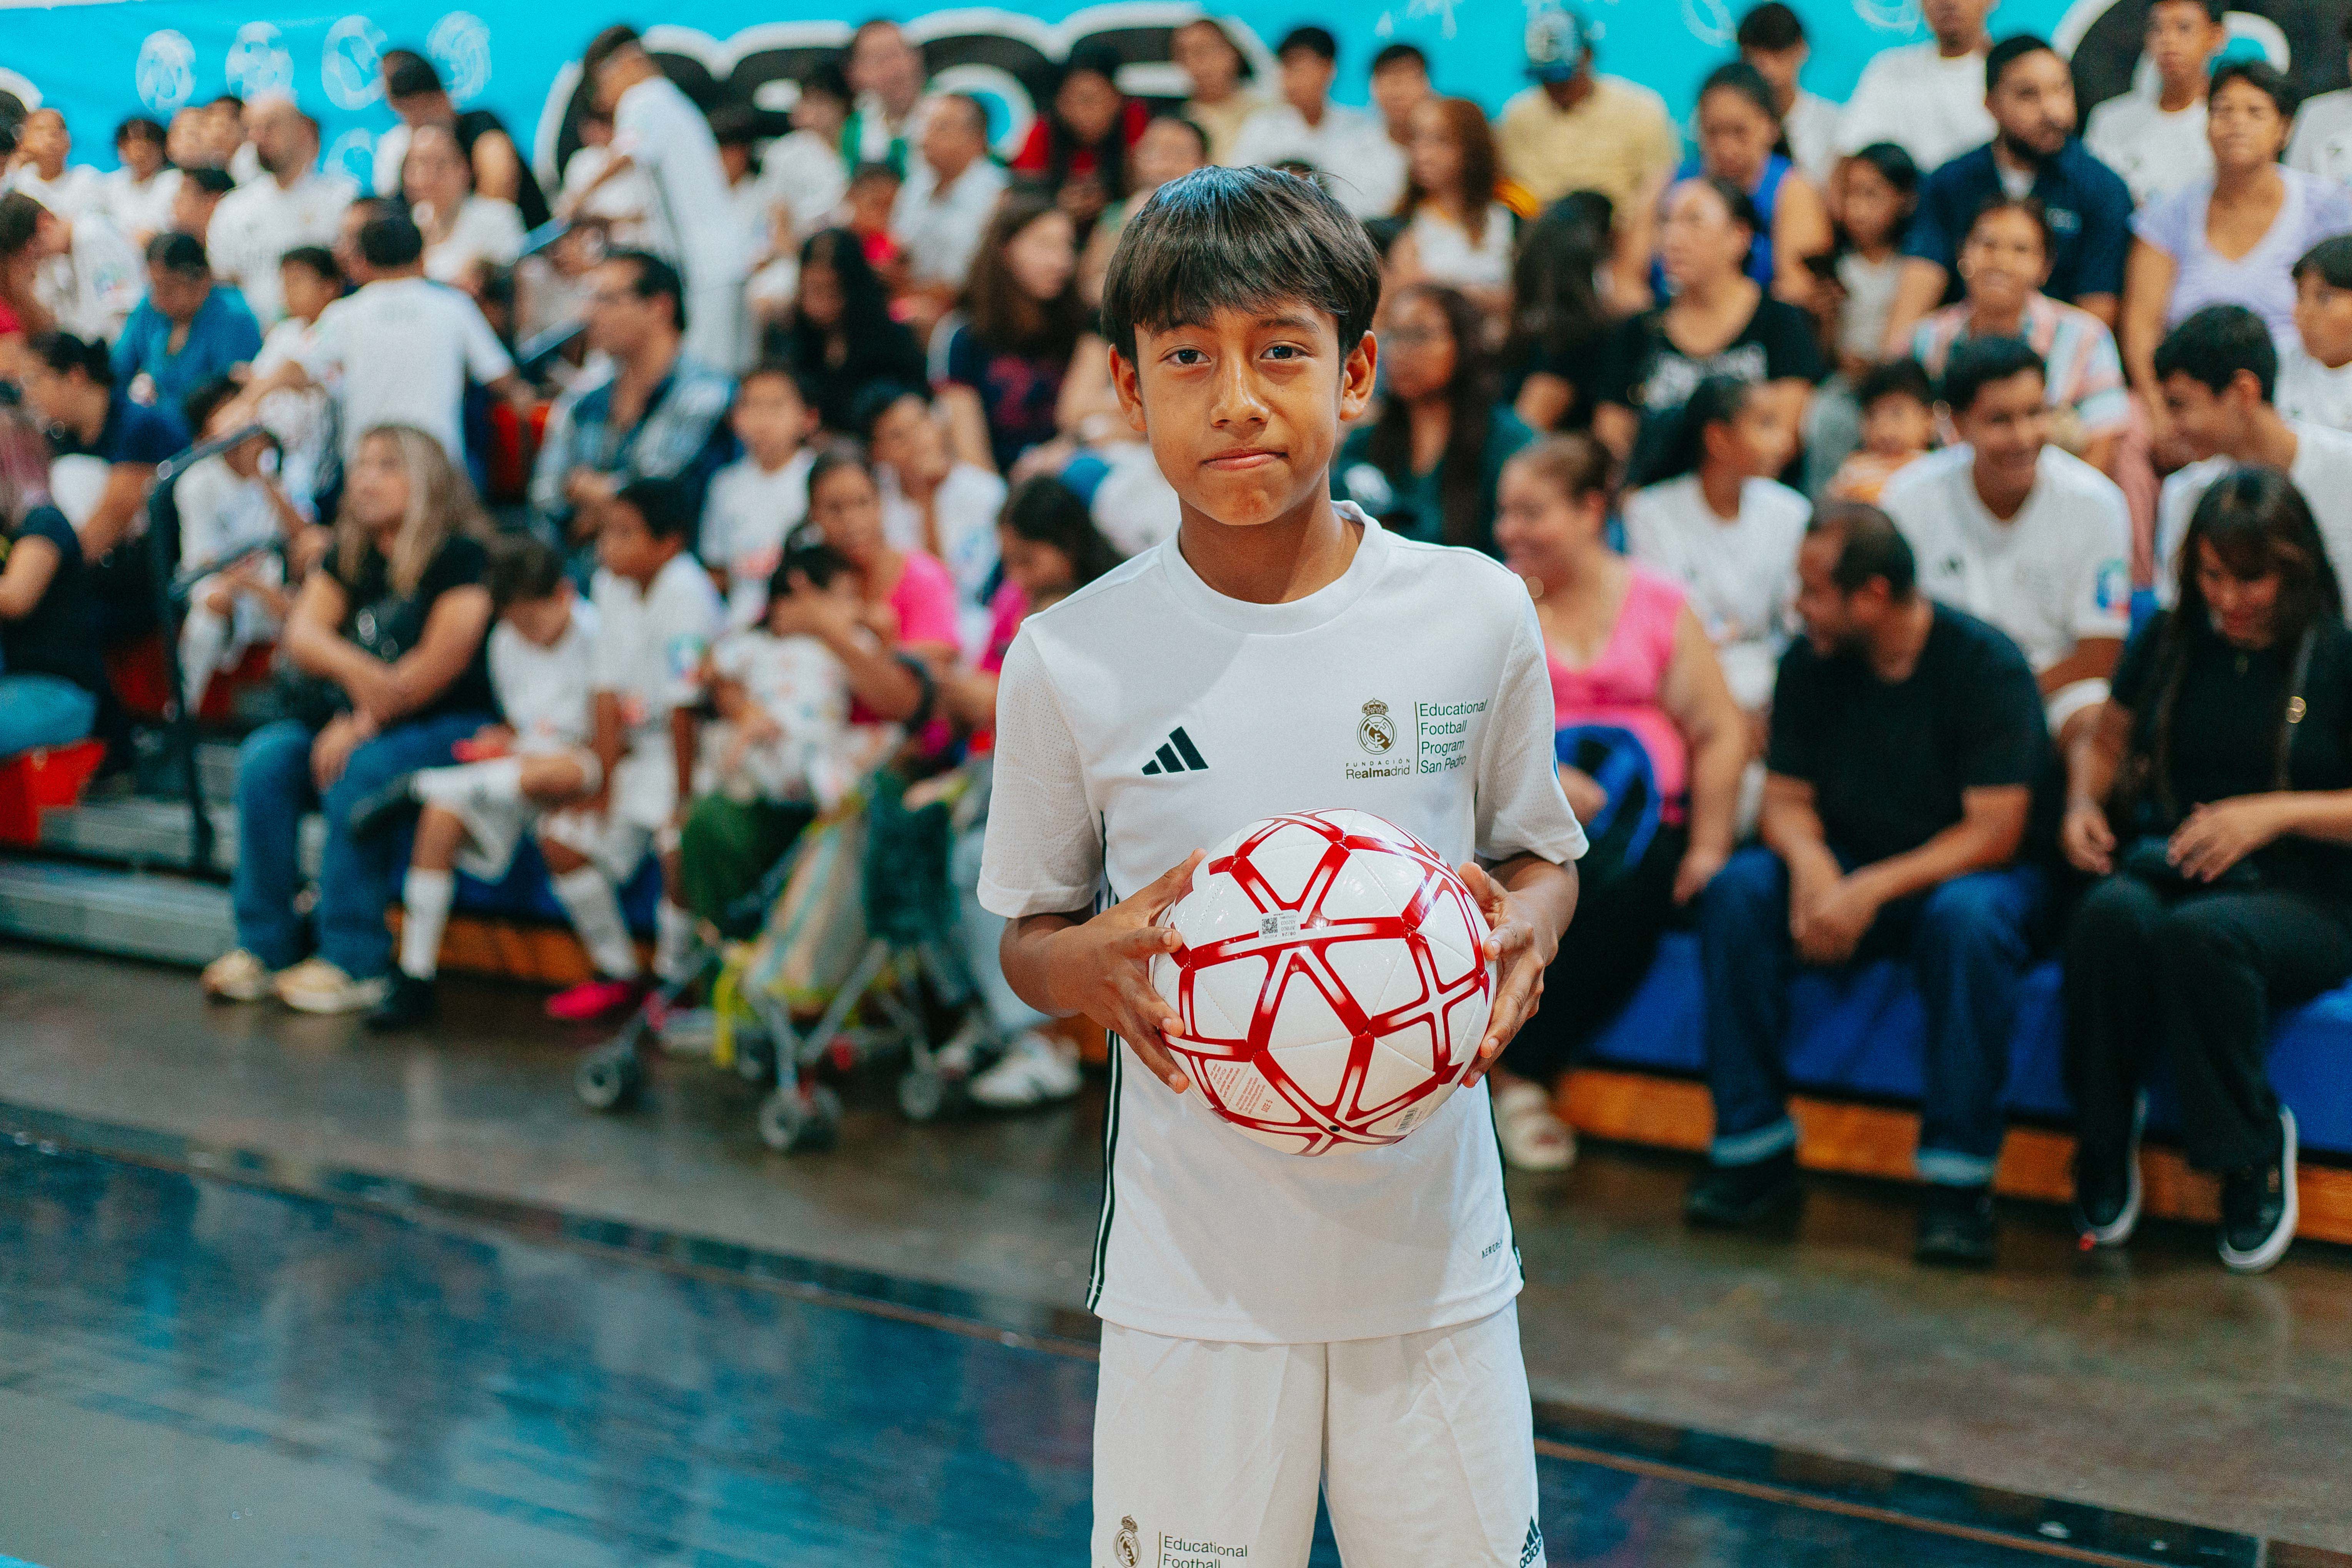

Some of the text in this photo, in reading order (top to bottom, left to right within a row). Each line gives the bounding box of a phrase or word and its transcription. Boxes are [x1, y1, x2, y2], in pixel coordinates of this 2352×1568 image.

[1420, 699, 1488, 717] Educational
[1421, 719, 1467, 736] Football
[1421, 740, 1465, 756] Program
[1346, 764, 1410, 780] Realmadrid
[1420, 754, 1466, 773] San Pedro
[1261, 1103, 1271, 1113] SIZE
[1164, 1535, 1248, 1557] Educational
